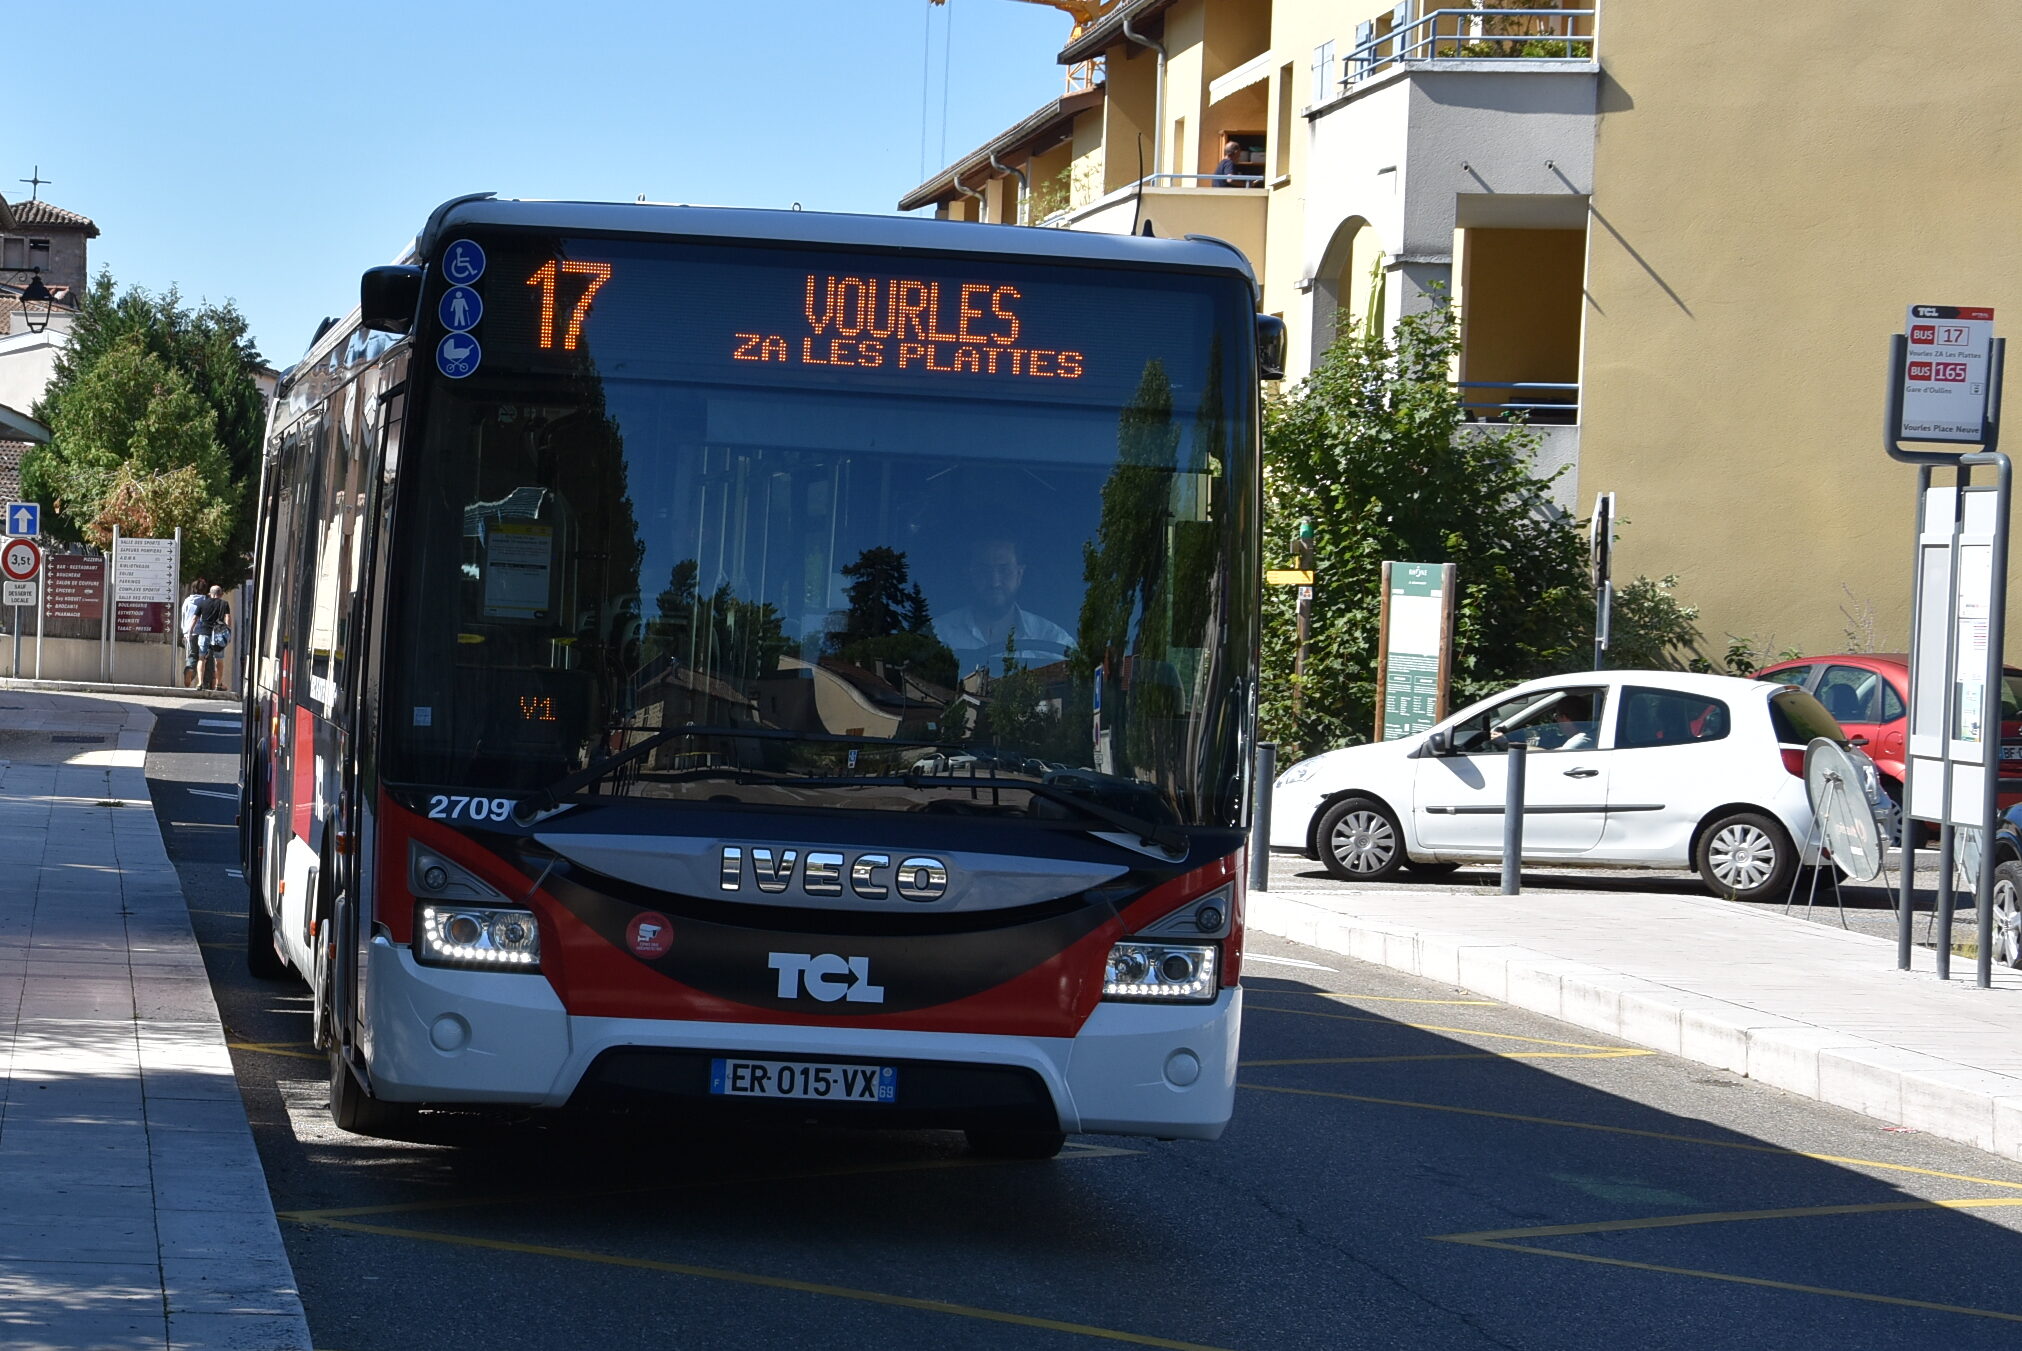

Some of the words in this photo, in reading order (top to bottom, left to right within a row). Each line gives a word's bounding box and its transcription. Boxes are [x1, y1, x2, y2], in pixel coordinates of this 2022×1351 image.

[526, 260, 611, 350] 17
[805, 274, 1021, 345] VOURLES
[1917, 307, 1939, 317] TCL
[1913, 329, 1934, 340] BUS
[1943, 328, 1964, 344] 17
[734, 333, 787, 362] ZA
[802, 337, 884, 367] LES
[898, 342, 1083, 378] PLATTES
[1934, 350, 1944, 358] ZA
[1945, 351, 1957, 359] Les
[1957, 351, 1982, 359] Plattes
[1910, 366, 1931, 376] BUS
[1935, 364, 1966, 380] 165
[1905, 385, 1922, 393] Gare
[1922, 386, 1953, 394] d'Oullins
[1903, 423, 1932, 432] Vourles
[1933, 424, 1954, 433] Place
[1955, 425, 1980, 434] Neuve
[11, 554, 31, 566] 3,5t
[520, 696, 556, 720] V1
[428, 795, 511, 822] 2709
[720, 846, 949, 903] IVECO
[768, 952, 885, 1004] TCL
[713, 1079, 720, 1087] F
[731, 1063, 877, 1099] ER-015-VX
[879, 1085, 894, 1098] 69
